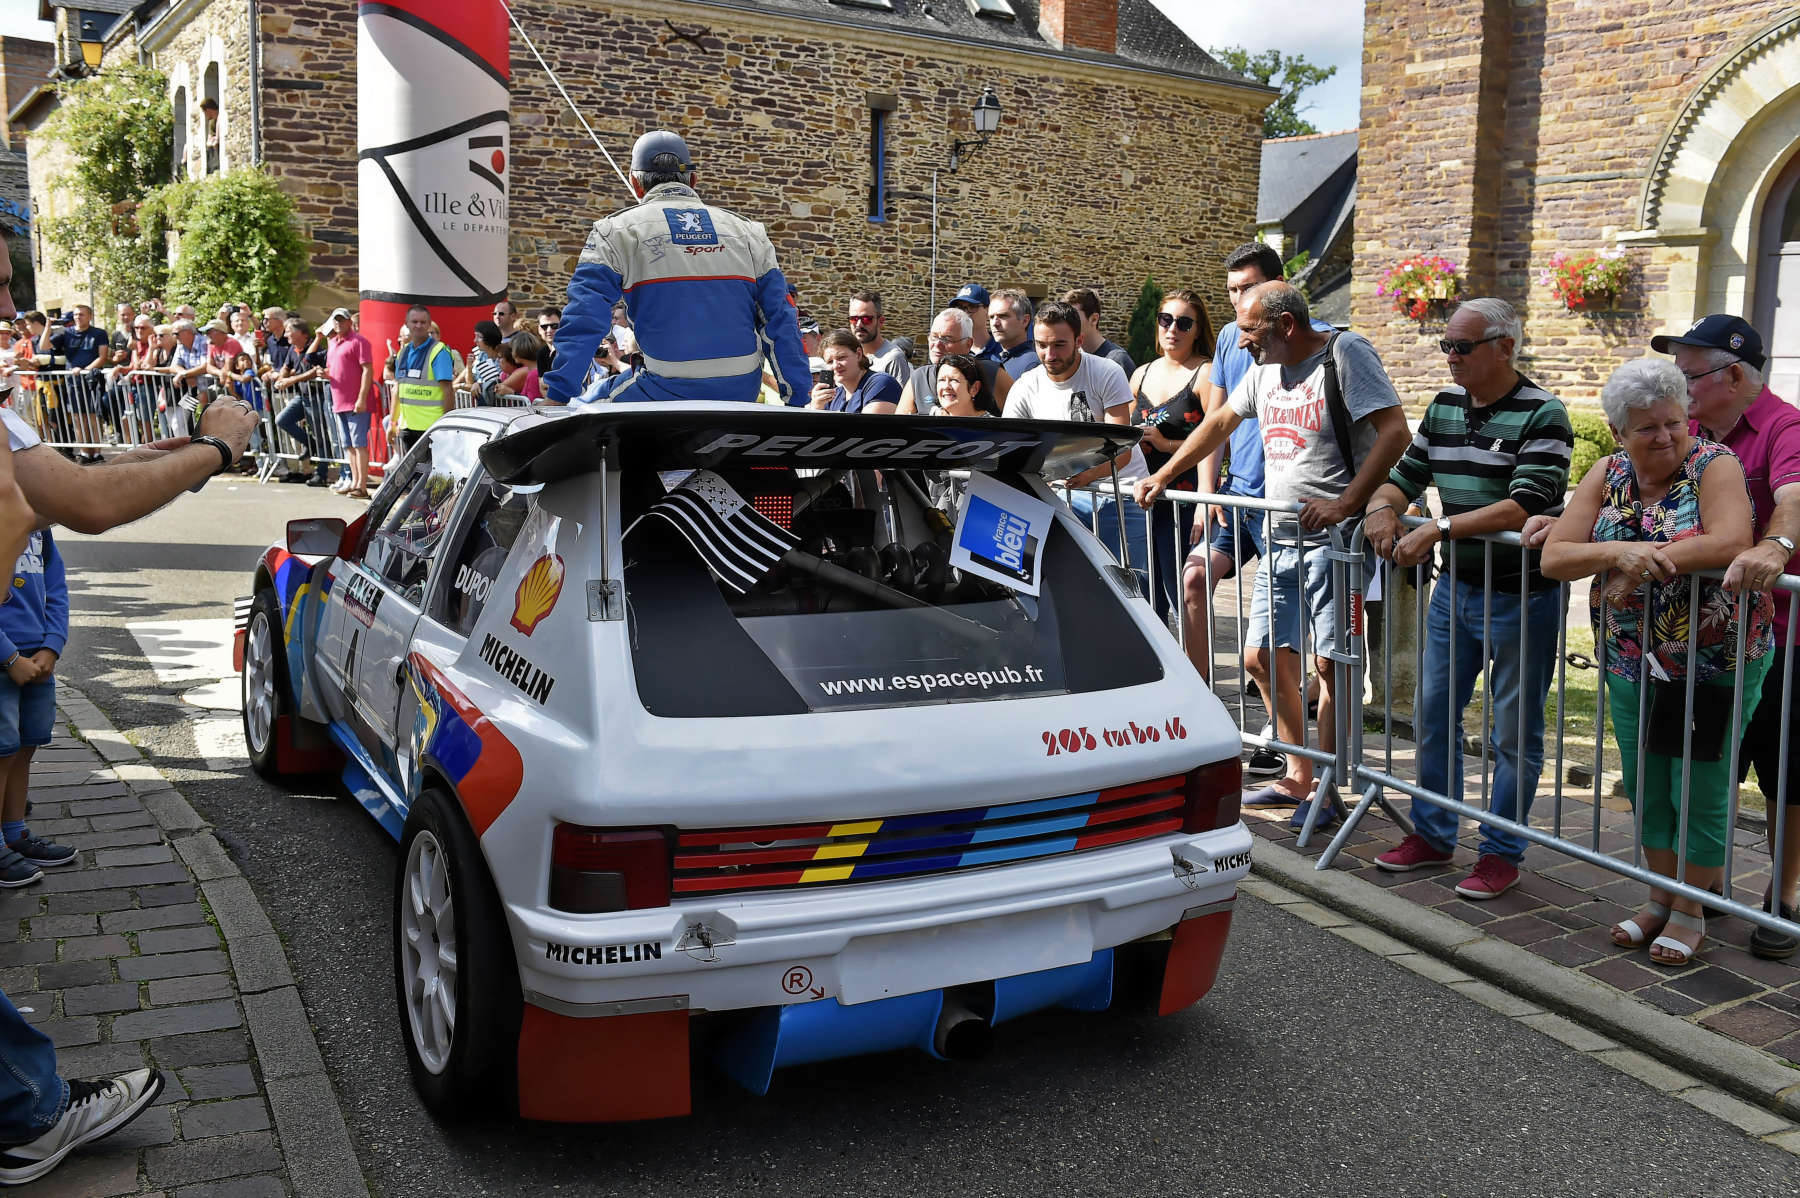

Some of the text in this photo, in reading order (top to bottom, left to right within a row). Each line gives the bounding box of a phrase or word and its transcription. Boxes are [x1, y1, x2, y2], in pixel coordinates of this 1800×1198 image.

[424, 192, 461, 214] Ille
[467, 192, 486, 217] &
[443, 222, 456, 230] LE
[693, 433, 1043, 460] PEUGEOT
[993, 511, 1008, 544] france
[994, 515, 1029, 570] bleu
[350, 575, 378, 611] AXEL
[478, 632, 556, 706] MICHELIN
[819, 664, 1044, 696] www.espacepub.fr
[1042, 717, 1187, 756] 205 turbo 16
[1214, 850, 1252, 873] MICHE
[545, 942, 662, 965] MICHELIN
